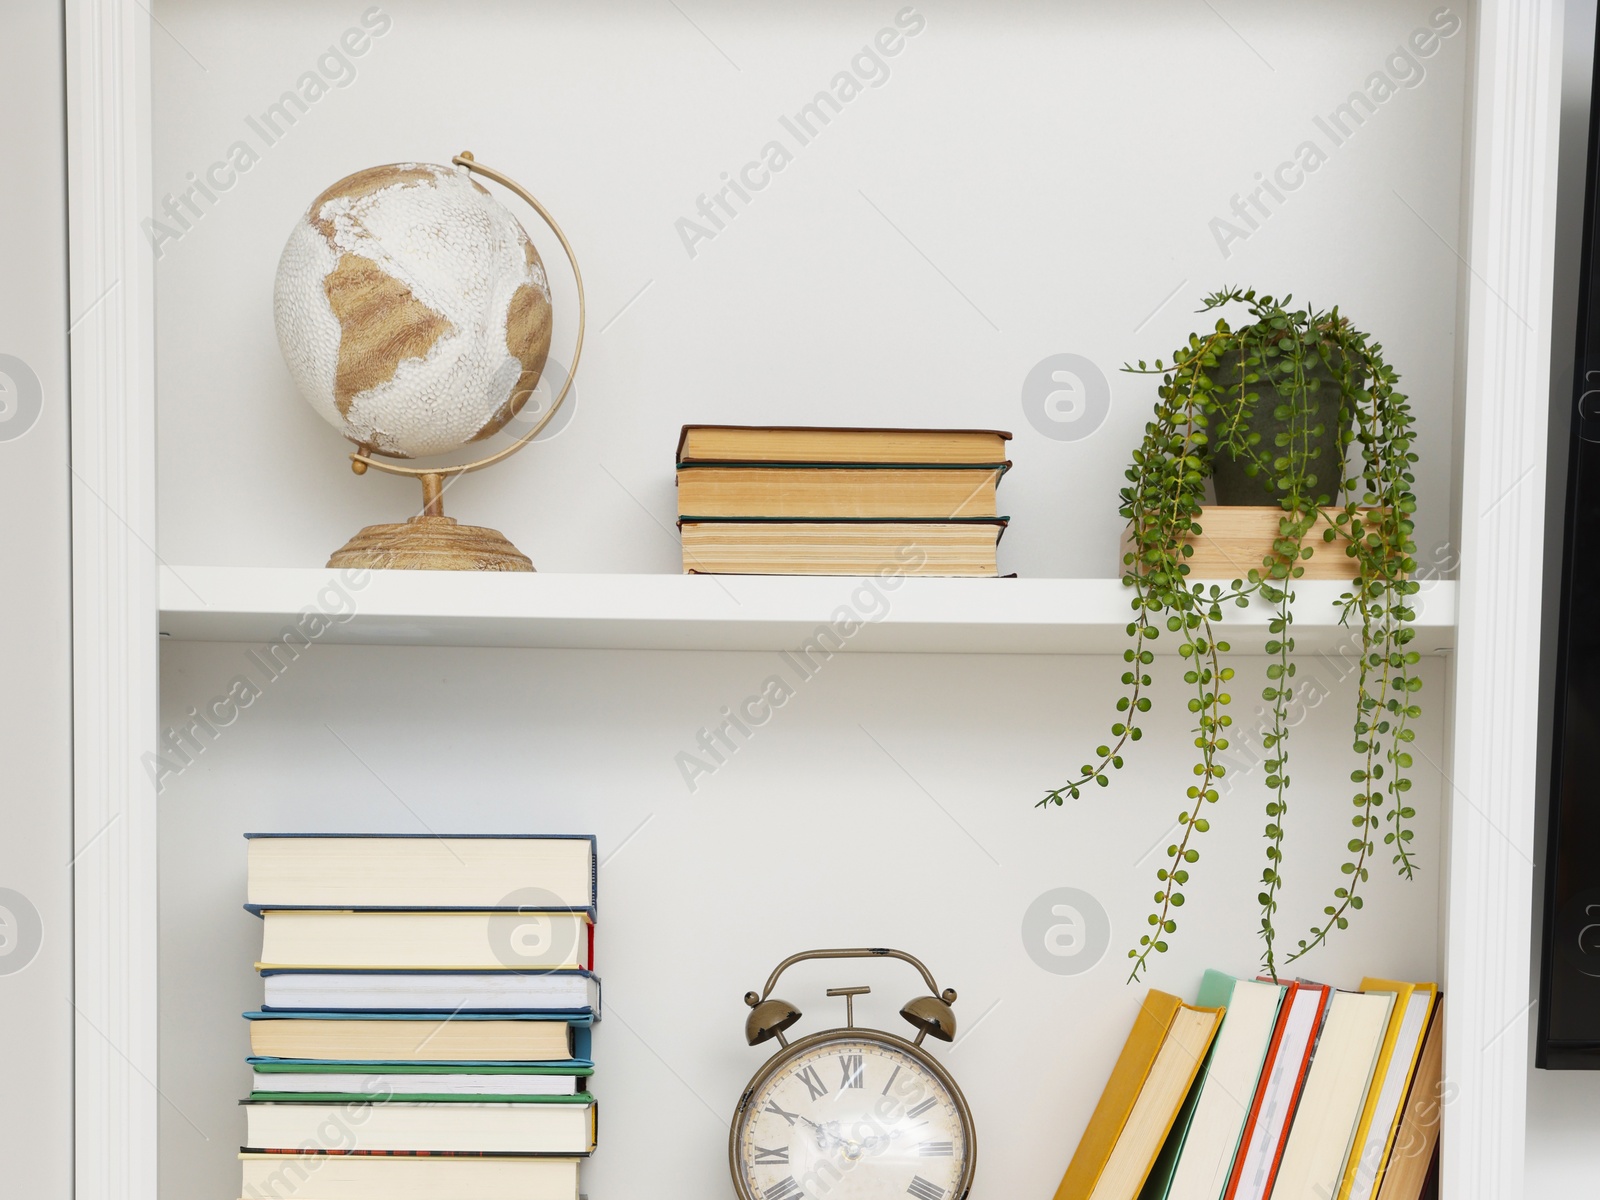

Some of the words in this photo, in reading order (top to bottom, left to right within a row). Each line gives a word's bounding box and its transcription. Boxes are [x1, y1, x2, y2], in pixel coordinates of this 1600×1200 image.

[795, 1064, 829, 1102] XI
[839, 1054, 864, 1089] XII
[881, 1065, 901, 1096] I
[765, 1099, 799, 1126] X
[906, 1095, 938, 1119] II
[754, 1146, 789, 1165] IX
[919, 1141, 953, 1157] III
